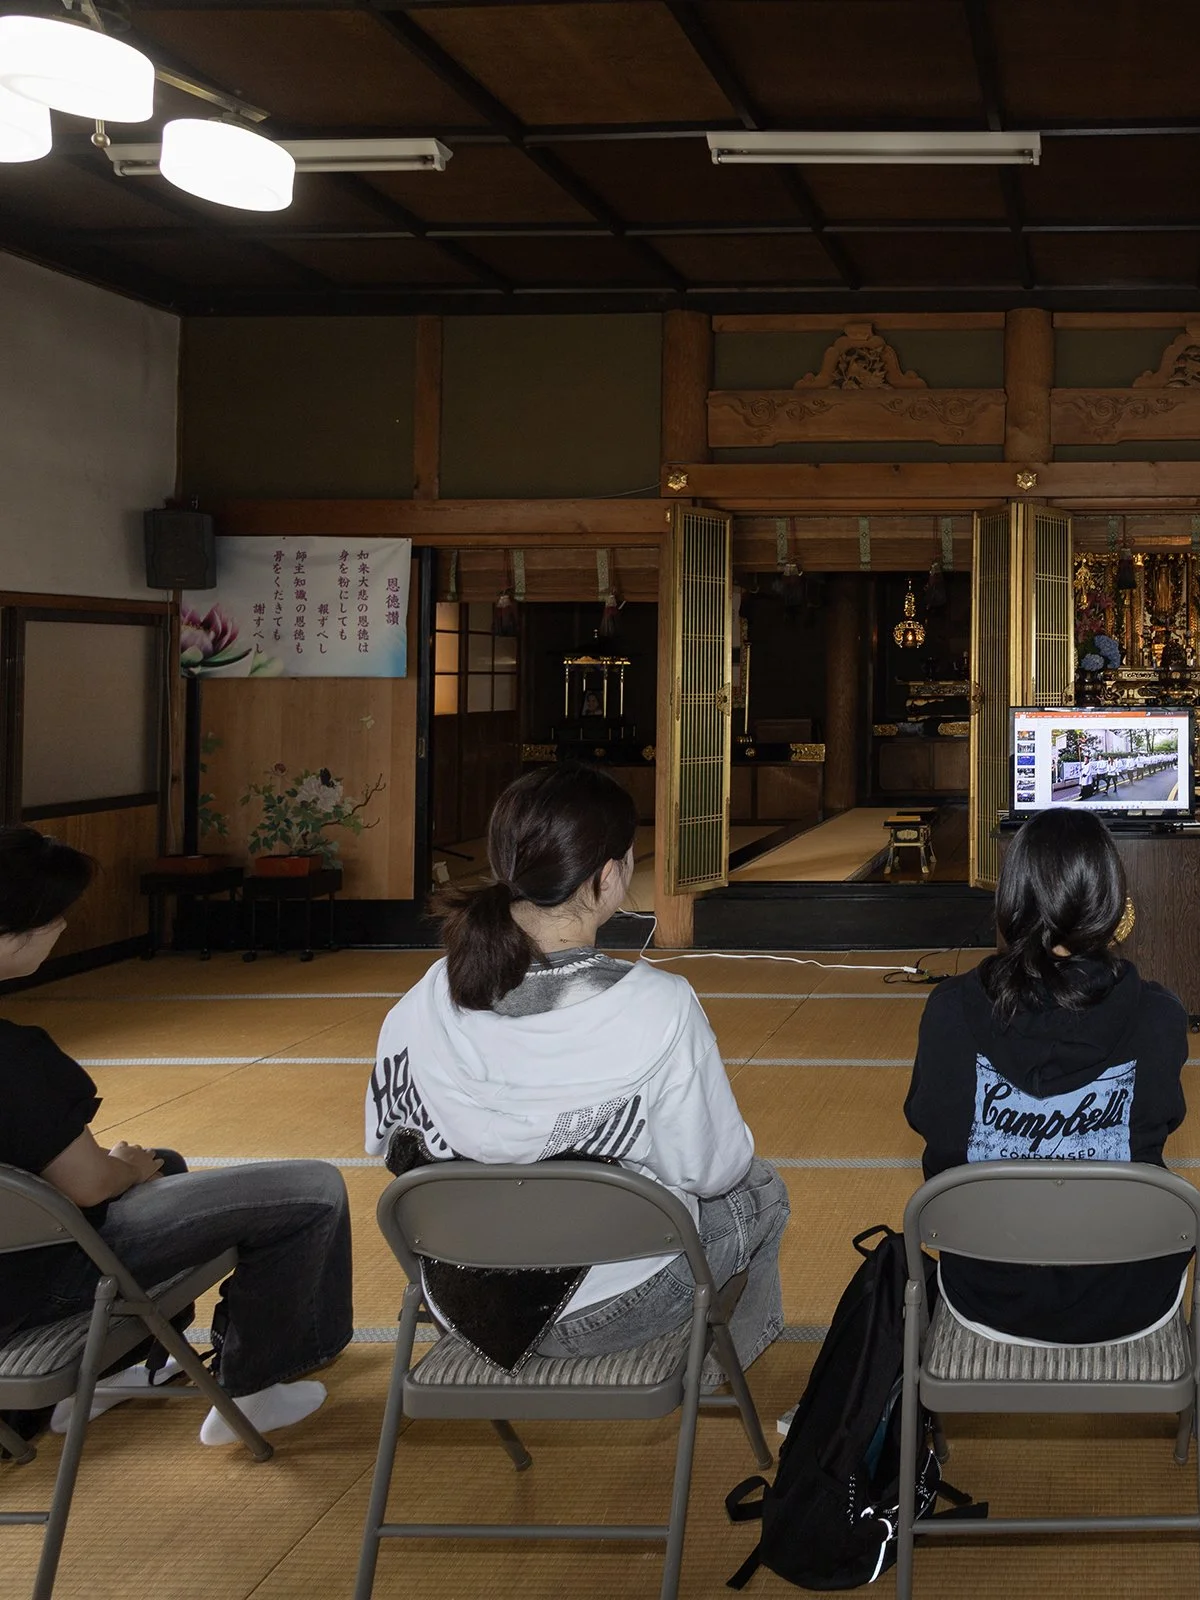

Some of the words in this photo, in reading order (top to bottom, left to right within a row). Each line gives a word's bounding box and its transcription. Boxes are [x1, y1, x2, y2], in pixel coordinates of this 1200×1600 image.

[253, 603, 265, 654] 謝すべし
[273, 550, 285, 641] 骨をくだきても
[294, 550, 307, 654] 師主知識の恩徳も
[317, 603, 329, 654] 報ずべし
[338, 550, 350, 640] 身を粉にしても
[357, 550, 370, 653] 如来大悲の恩徳は
